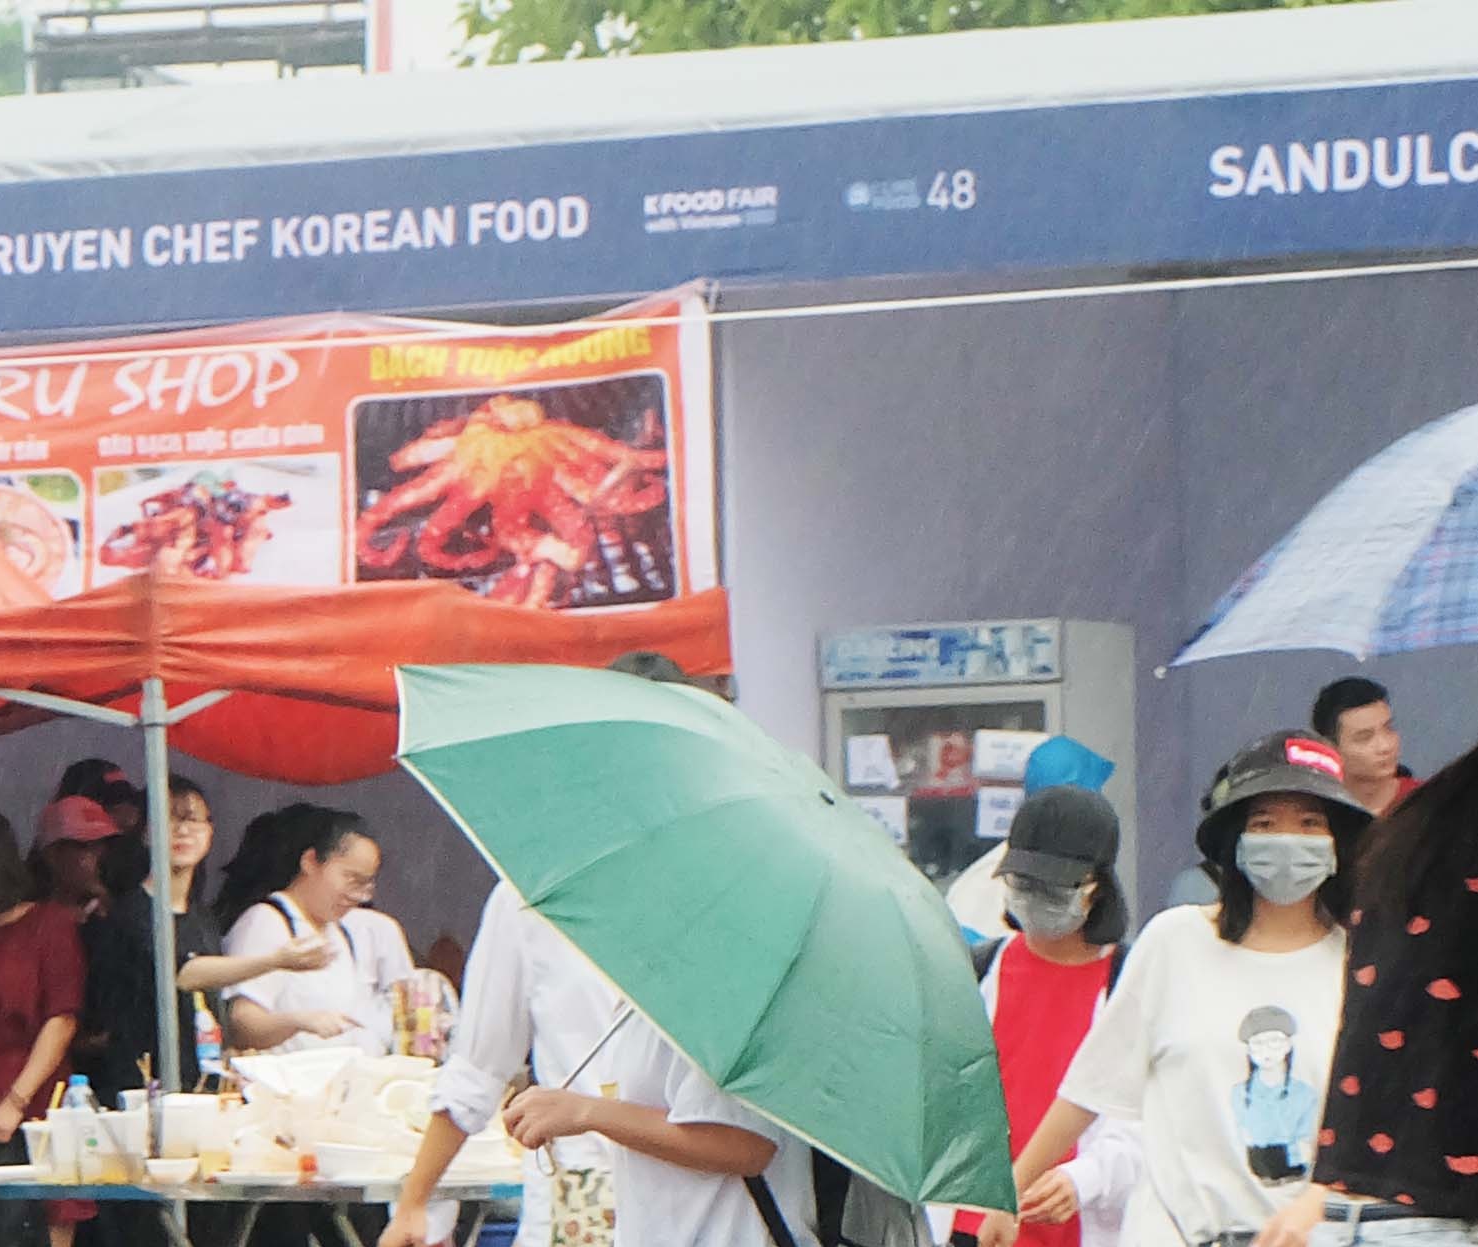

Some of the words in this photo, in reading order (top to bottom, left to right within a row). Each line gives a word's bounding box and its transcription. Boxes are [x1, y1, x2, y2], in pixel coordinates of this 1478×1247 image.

[927, 168, 977, 210] 48
[142, 219, 260, 267] CHEF
[271, 205, 456, 258] KOREAN
[467, 195, 589, 244] FOOD
[109, 346, 300, 417] SHOP
